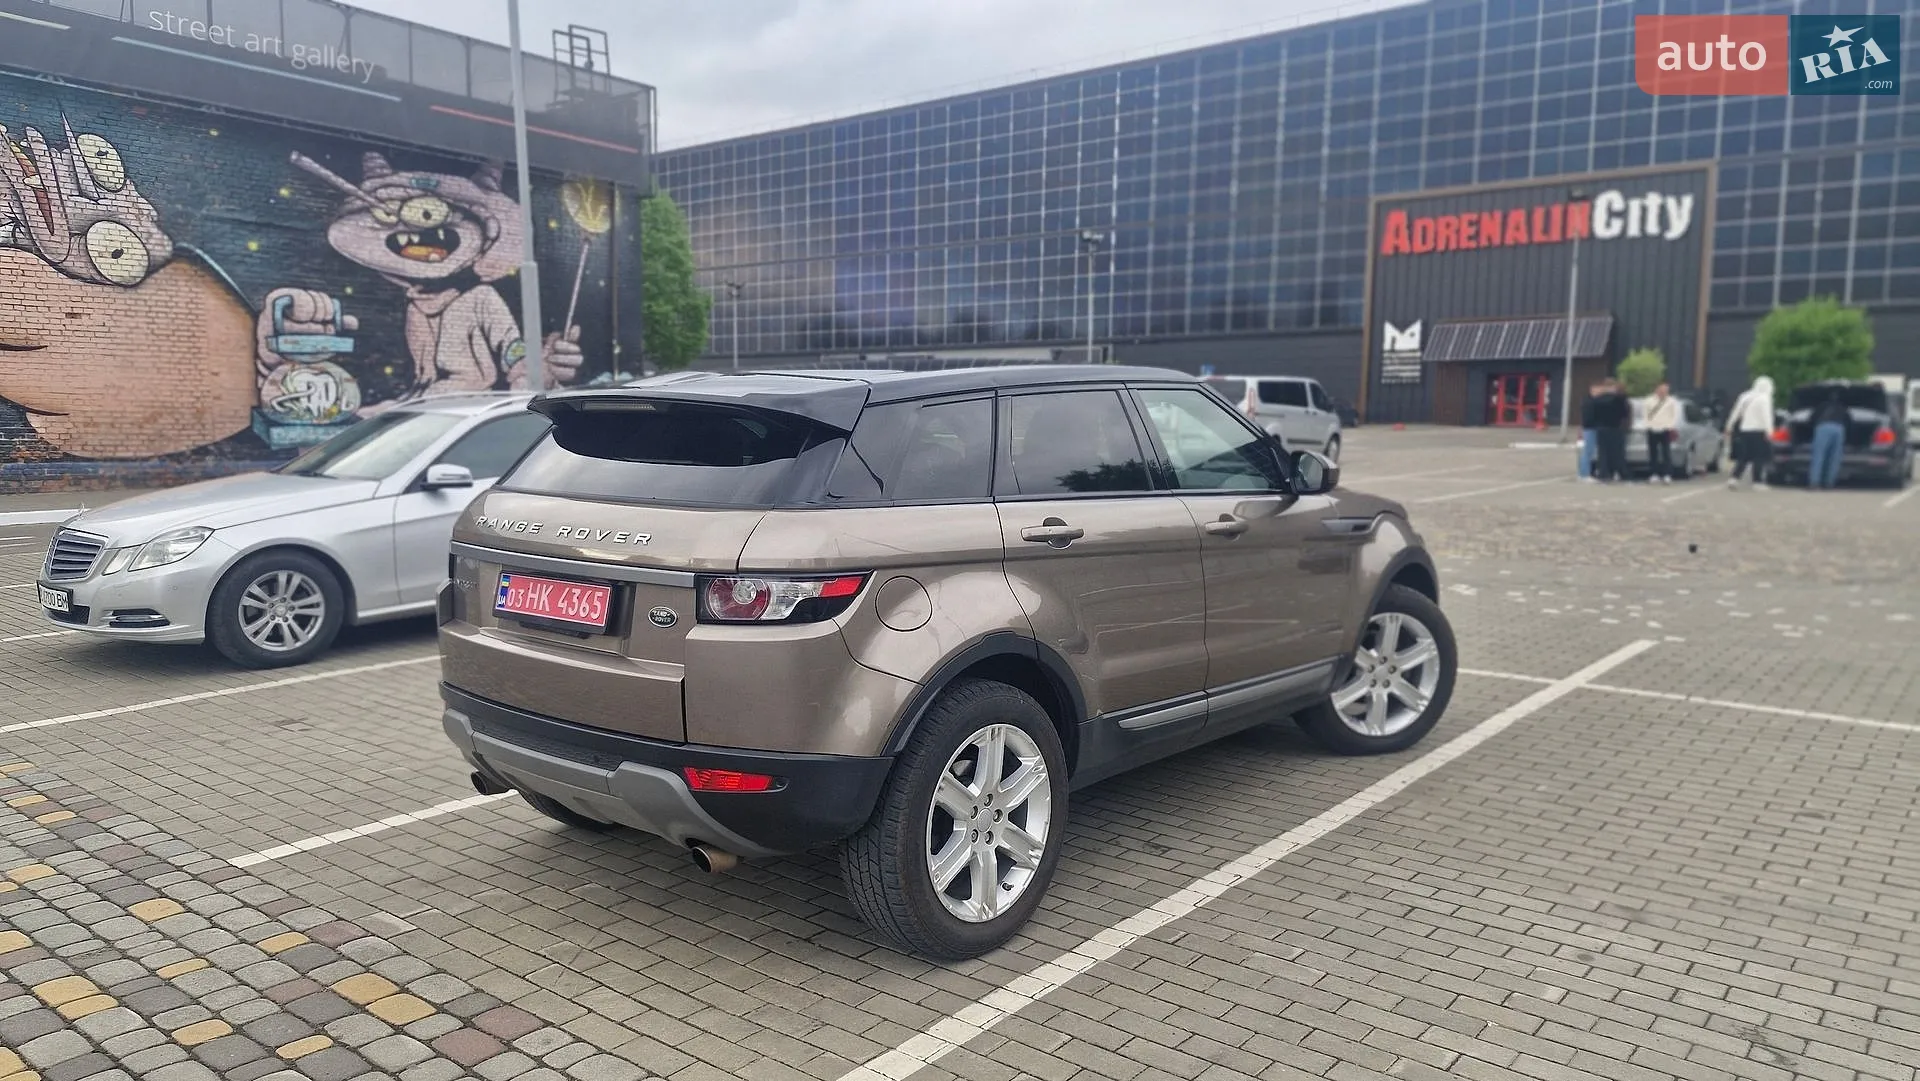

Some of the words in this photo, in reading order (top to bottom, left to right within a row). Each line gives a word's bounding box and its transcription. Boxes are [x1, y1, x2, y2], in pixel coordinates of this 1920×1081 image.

[149, 10, 237, 48] street
[244, 32, 283, 58] art
[291, 43, 375, 84] gallery
[475, 515, 544, 534] RANGE
[556, 525, 652, 546] ROVER
[507, 588, 525, 608] 03
[525, 582, 554, 612] HK
[557, 587, 603, 620] 4365
